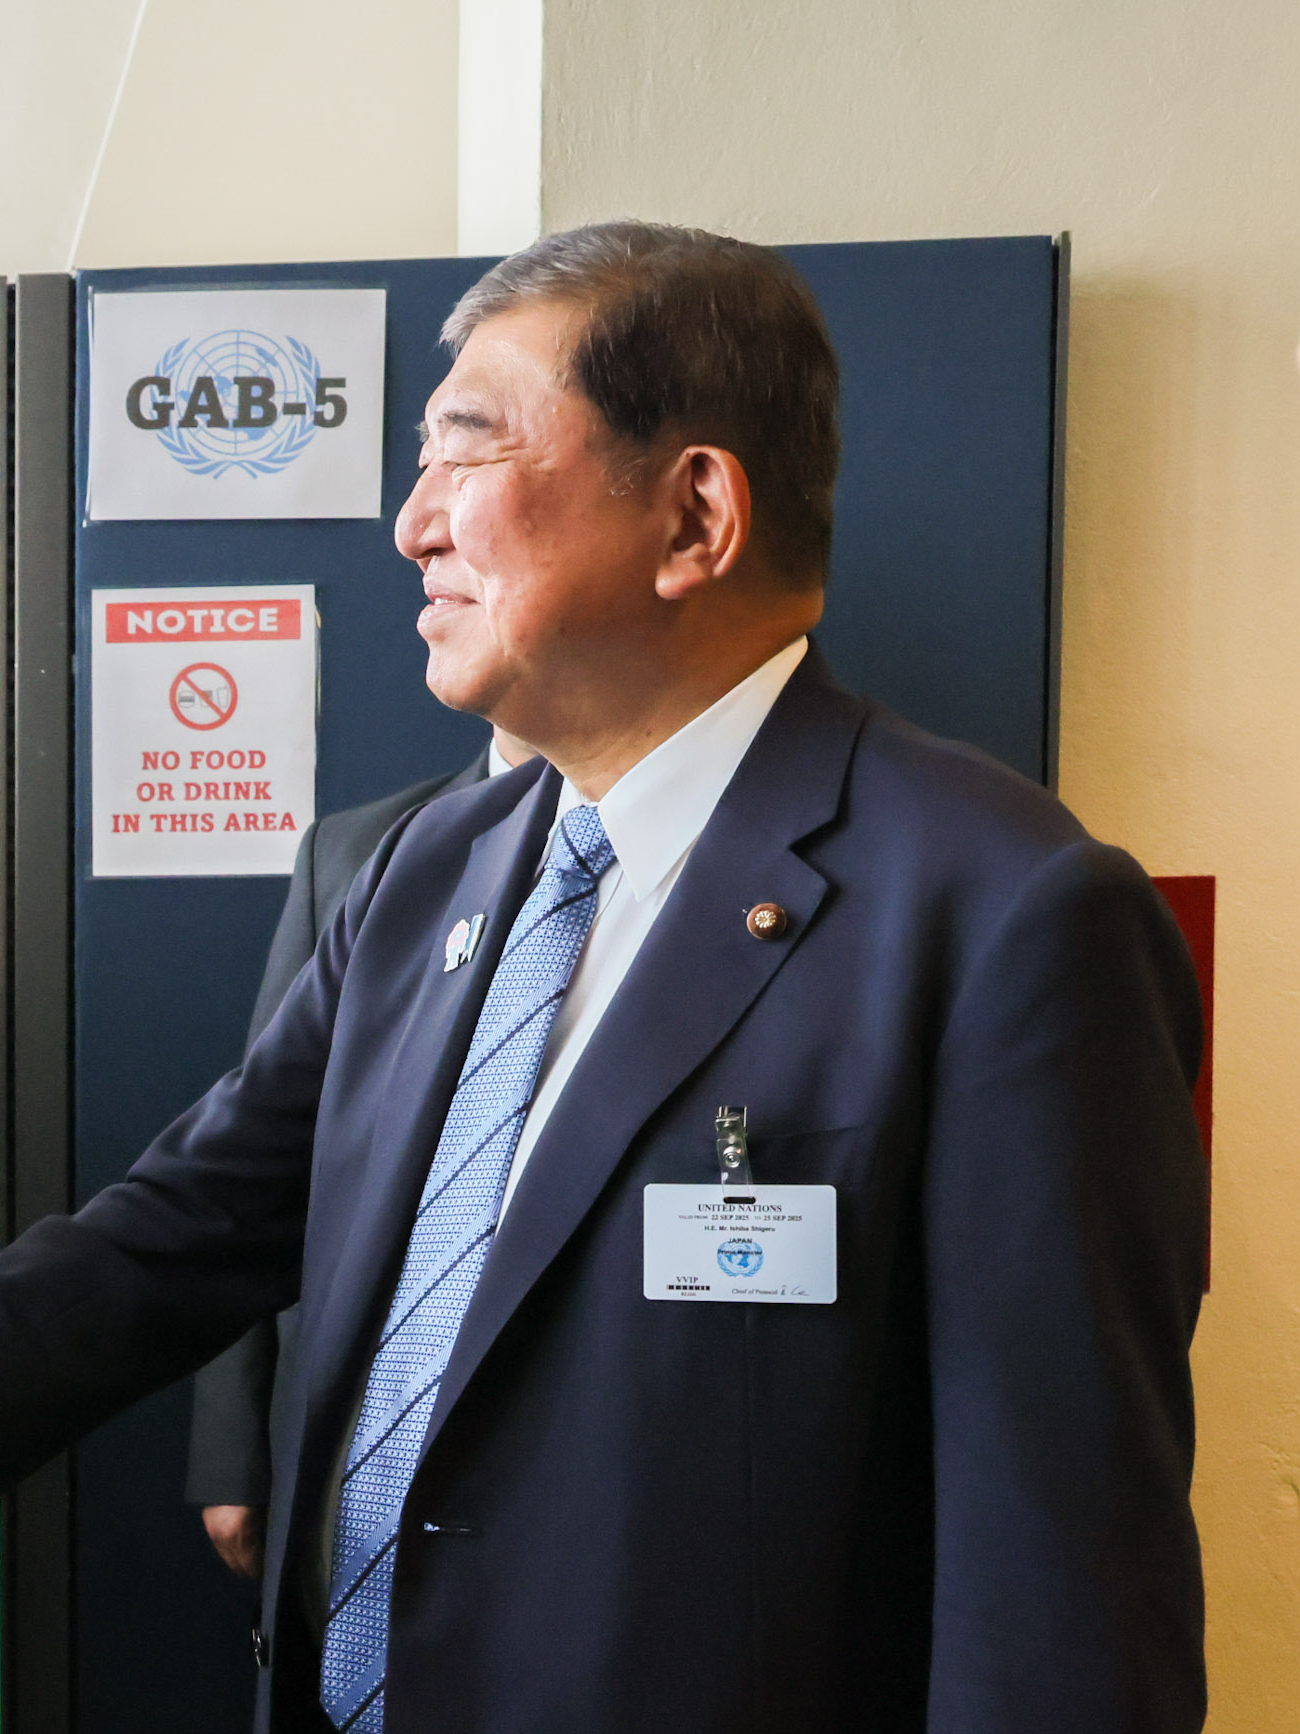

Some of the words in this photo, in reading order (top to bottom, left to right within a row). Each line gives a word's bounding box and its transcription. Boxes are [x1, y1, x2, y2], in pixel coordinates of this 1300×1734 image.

[125, 376, 348, 430] GAB-5
[127, 608, 278, 634] NOTICE
[142, 750, 181, 771] NO
[190, 748, 267, 770] FOOD
[137, 782, 175, 803] OR
[184, 780, 272, 802] DRINK
[112, 813, 141, 833] IN
[150, 812, 215, 832] THIS
[224, 811, 297, 832] AREA
[698, 1204, 735, 1212] UNITED
[738, 1204, 782, 1213] NATIONS
[676, 1276, 699, 1284] VVIP
